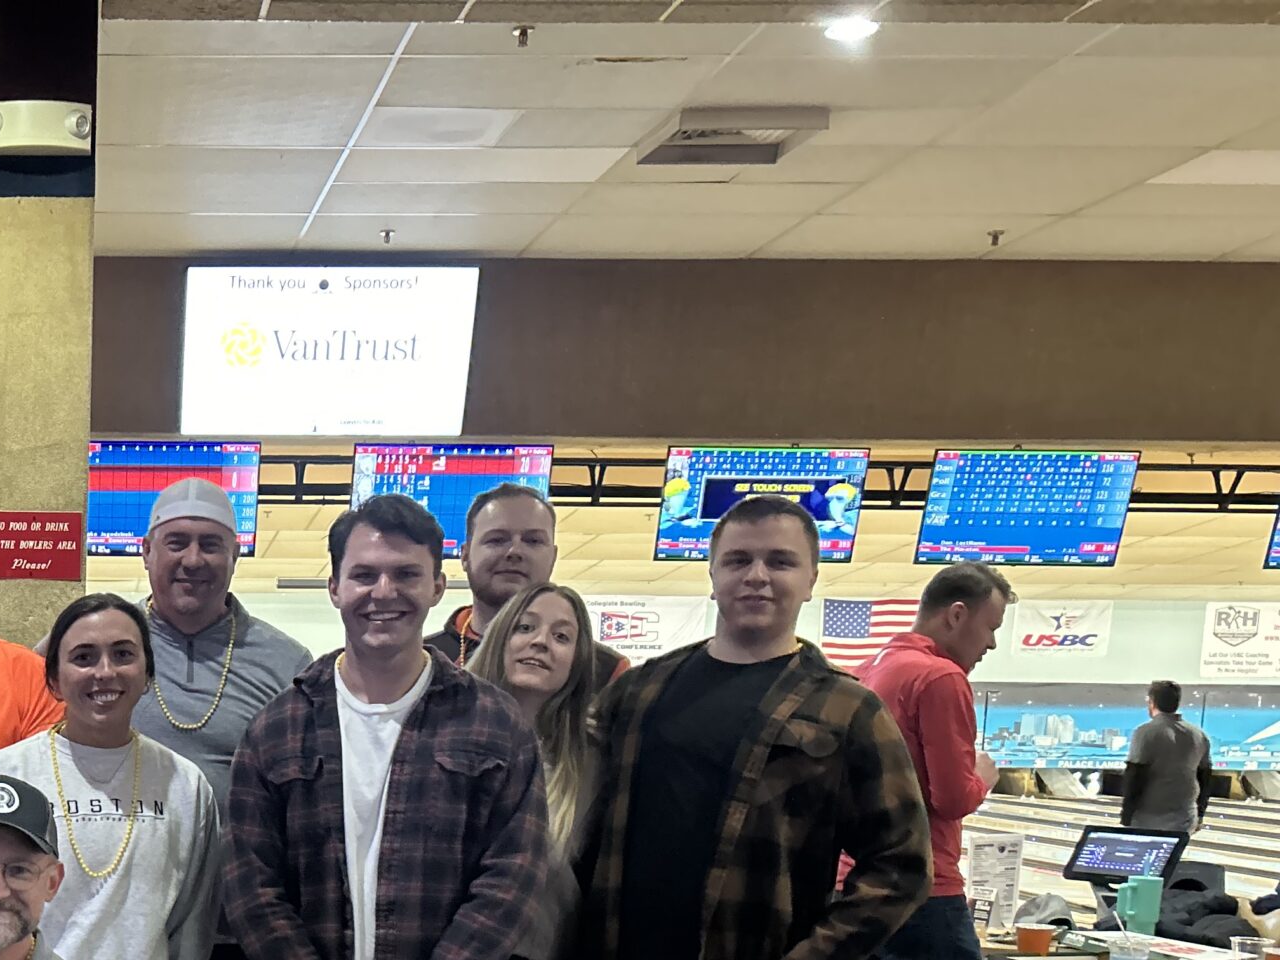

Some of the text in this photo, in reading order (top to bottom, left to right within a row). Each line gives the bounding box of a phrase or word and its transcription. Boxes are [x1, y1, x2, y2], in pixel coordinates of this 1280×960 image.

[229, 275, 419, 293] Thank you Sponsors!
[274, 330, 418, 360] VanTrust
[234, 456, 238, 464] 9
[520, 458, 530, 472] 20
[232, 472, 237, 488] 0
[735, 484, 815, 492] SEE TOUCH SCREEN
[232, 495, 254, 504] 0 200
[9, 522, 28, 530] FOOD
[30, 522, 42, 530] OR
[45, 522, 70, 532] DRINK
[0, 540, 16, 549] THE
[20, 540, 54, 550] BOWLERS
[56, 541, 76, 550] AREA
[12, 558, 52, 570] Please!
[1022, 634, 1098, 646] USBC
[1058, 760, 1094, 768] PALACE
